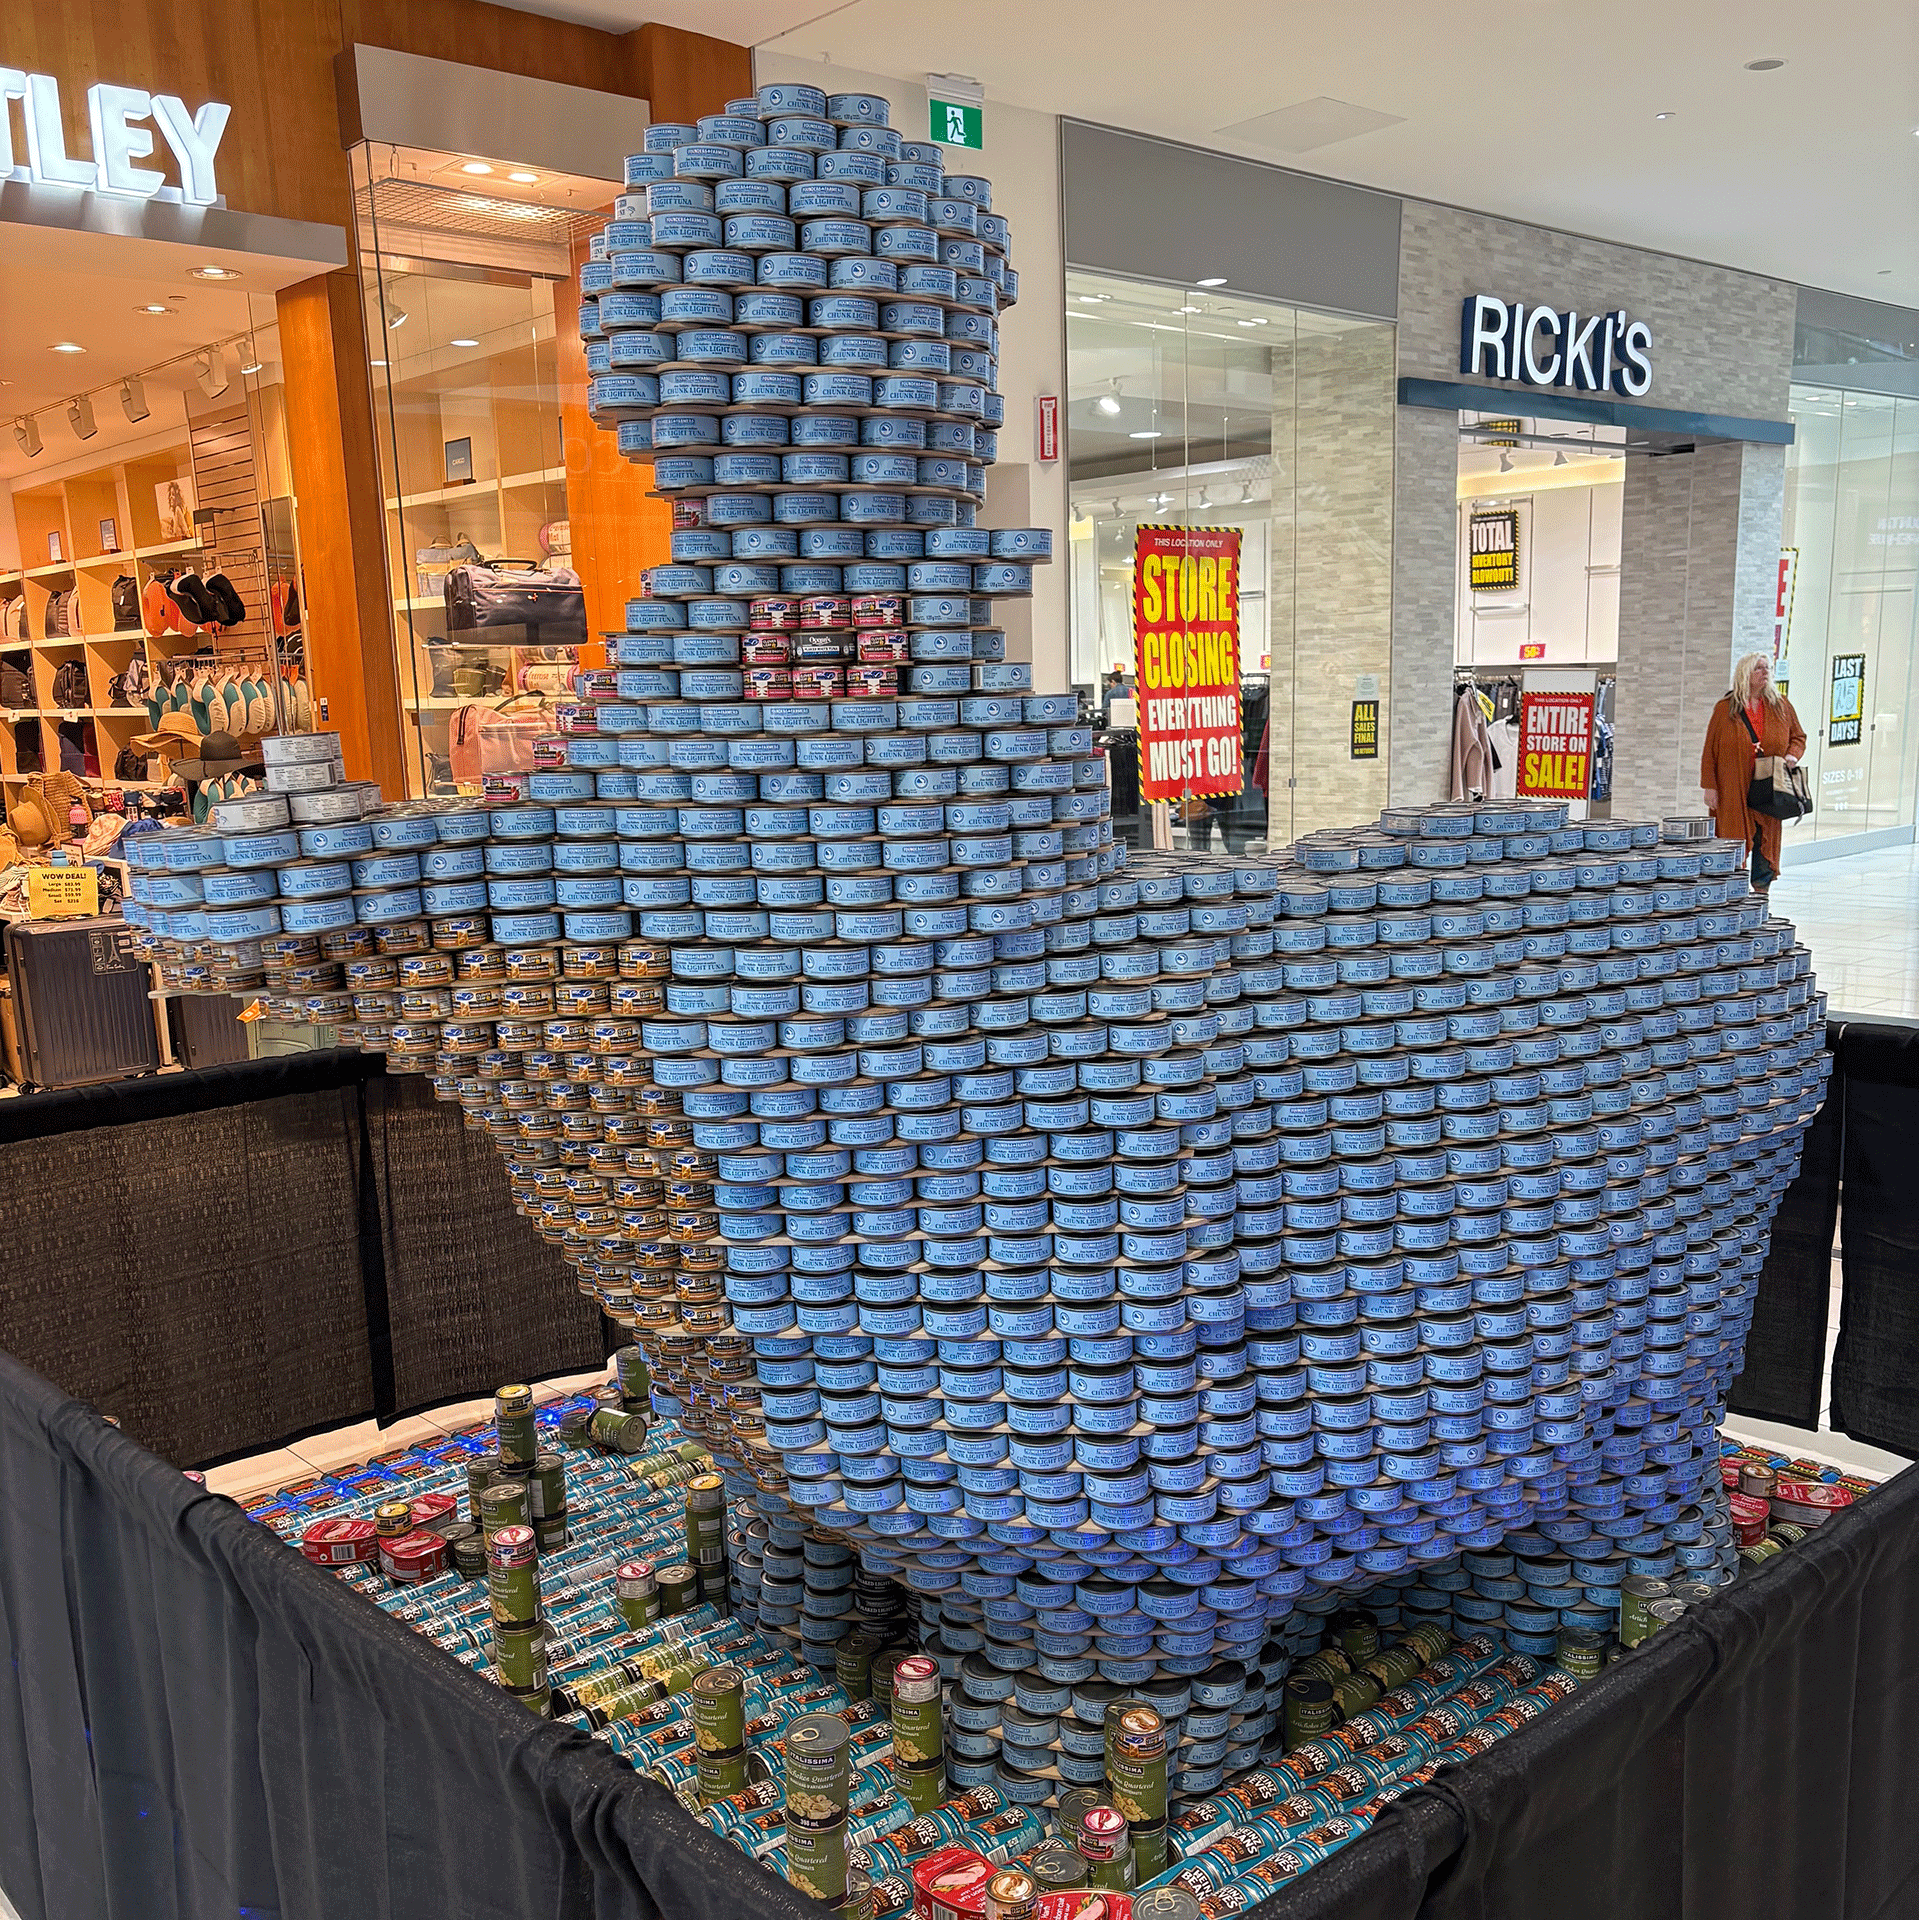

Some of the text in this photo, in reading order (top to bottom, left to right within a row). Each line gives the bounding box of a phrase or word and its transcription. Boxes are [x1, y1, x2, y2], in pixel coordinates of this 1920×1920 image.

[706, 132, 764, 143] CHUNK LIGHT TUNA
[792, 134, 815, 143] CHUNK
[679, 160, 738, 171] CHUNK LIGHT TUNA
[740, 197, 760, 205] LIGHT
[761, 198, 777, 206] TUNA
[794, 199, 814, 207] CHUNK
[815, 199, 836, 208] LIGHT
[657, 229, 717, 239] CHUNK LIGHT TUNA
[690, 306, 711, 314] LIGHT
[711, 307, 727, 315] TUNA
[709, 346, 731, 354] LIGHT
[731, 346, 743, 355] TUNA
[1462, 294, 1652, 397] RICKI'S
[608, 390, 627, 398] LIGHT
[690, 387, 710, 395] LIGHT
[1154, 538, 1223, 548] THIS LOCATION ONLY
[1472, 520, 1514, 552] TOTAL
[1142, 553, 1233, 624] STORE
[1143, 630, 1235, 689] CLOSING
[1835, 658, 1862, 679] LAST
[1147, 694, 1237, 731] EVERYTHING
[1354, 704, 1375, 721] ALL
[1527, 706, 1589, 735] ENTIRE
[1354, 722, 1375, 732] SALES
[1831, 721, 1858, 742] DAYS!
[1354, 732, 1375, 744] FINAL
[1526, 735, 1587, 753] STORE ON
[1149, 736, 1237, 782] MUST GO!
[1524, 752, 1586, 790] SALE!
[1822, 770, 1846, 784] SIZES
[620, 823, 641, 831] CHUNK
[661, 822, 675, 830] TUNA
[229, 848, 291, 860] CHUNK LIGHT TUNA
[220, 924, 261, 936] LIGHT TUNA
[738, 965, 757, 973] CHUNK
[758, 964, 775, 973] LIGHT
[1513, 1655, 1536, 1674] HEINZ
[1354, 1717, 1378, 1739] HEINZ
[1426, 1711, 1455, 1735] BEANS
[1435, 1709, 1459, 1729] HEINZ
[790, 1752, 833, 1765] ITALISSIMA
[1305, 1745, 1329, 1767] HEINZ
[1254, 1773, 1278, 1794] HEINZ
[1341, 1766, 1366, 1787] HEINZ
[979, 1785, 998, 1806] HEINZ
[916, 1817, 938, 1839] HEINZ
[1237, 1827, 1263, 1847] HEINZ
[885, 1877, 908, 1898] HEINZ
